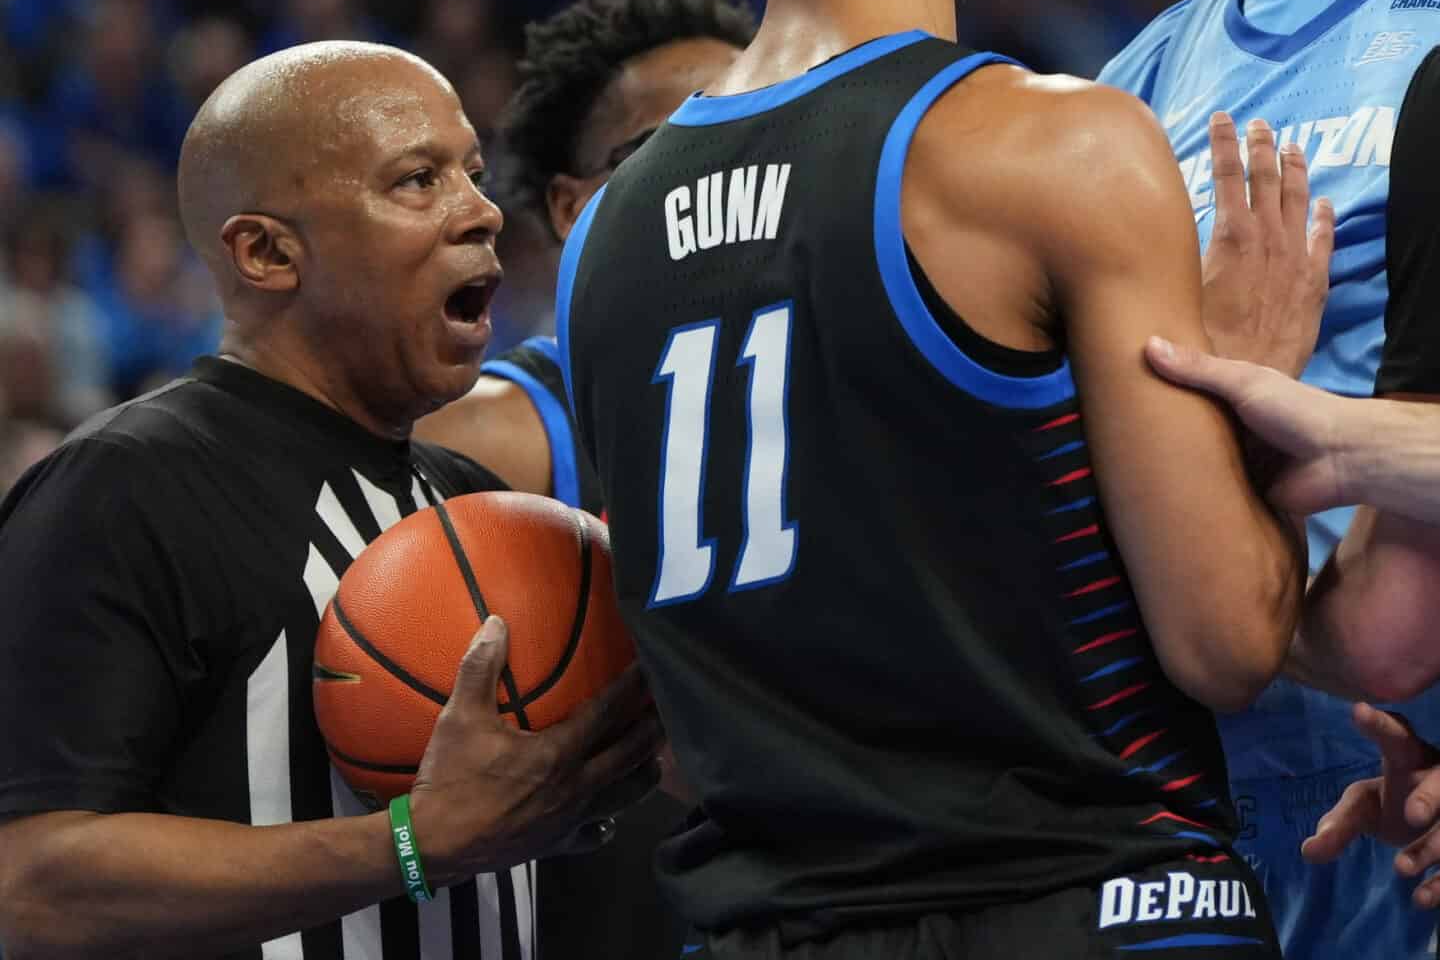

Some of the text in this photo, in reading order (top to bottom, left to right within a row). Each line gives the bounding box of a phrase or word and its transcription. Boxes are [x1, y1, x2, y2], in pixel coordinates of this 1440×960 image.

[664, 163, 792, 261] GUNN
[646, 298, 799, 610] 11
[406, 860, 421, 888] You
